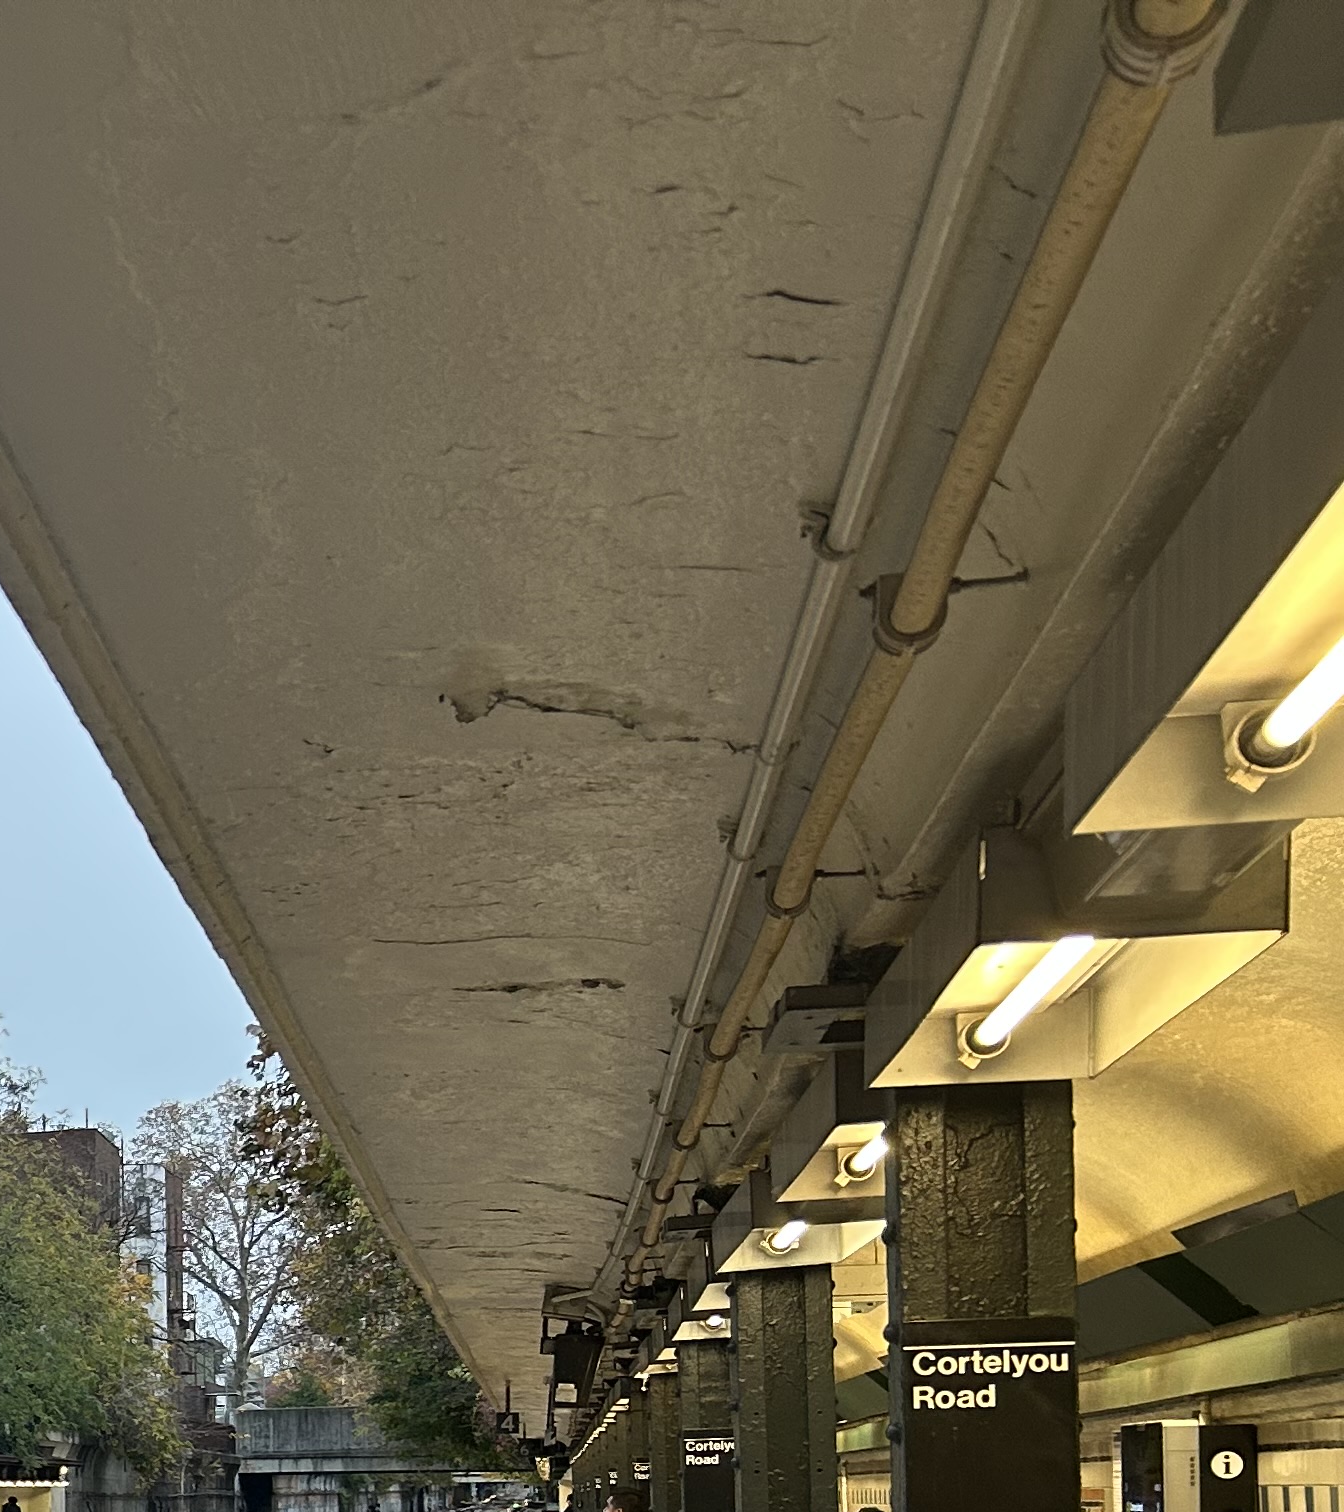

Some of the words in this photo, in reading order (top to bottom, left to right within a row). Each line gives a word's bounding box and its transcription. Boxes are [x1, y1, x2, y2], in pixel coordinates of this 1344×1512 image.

[912, 1349, 1070, 1378] Cortelyou
[912, 1384, 997, 1409] Road
[500, 1414, 515, 1432] 4
[685, 1440, 735, 1453] Cortely
[685, 1453, 720, 1466] Road
